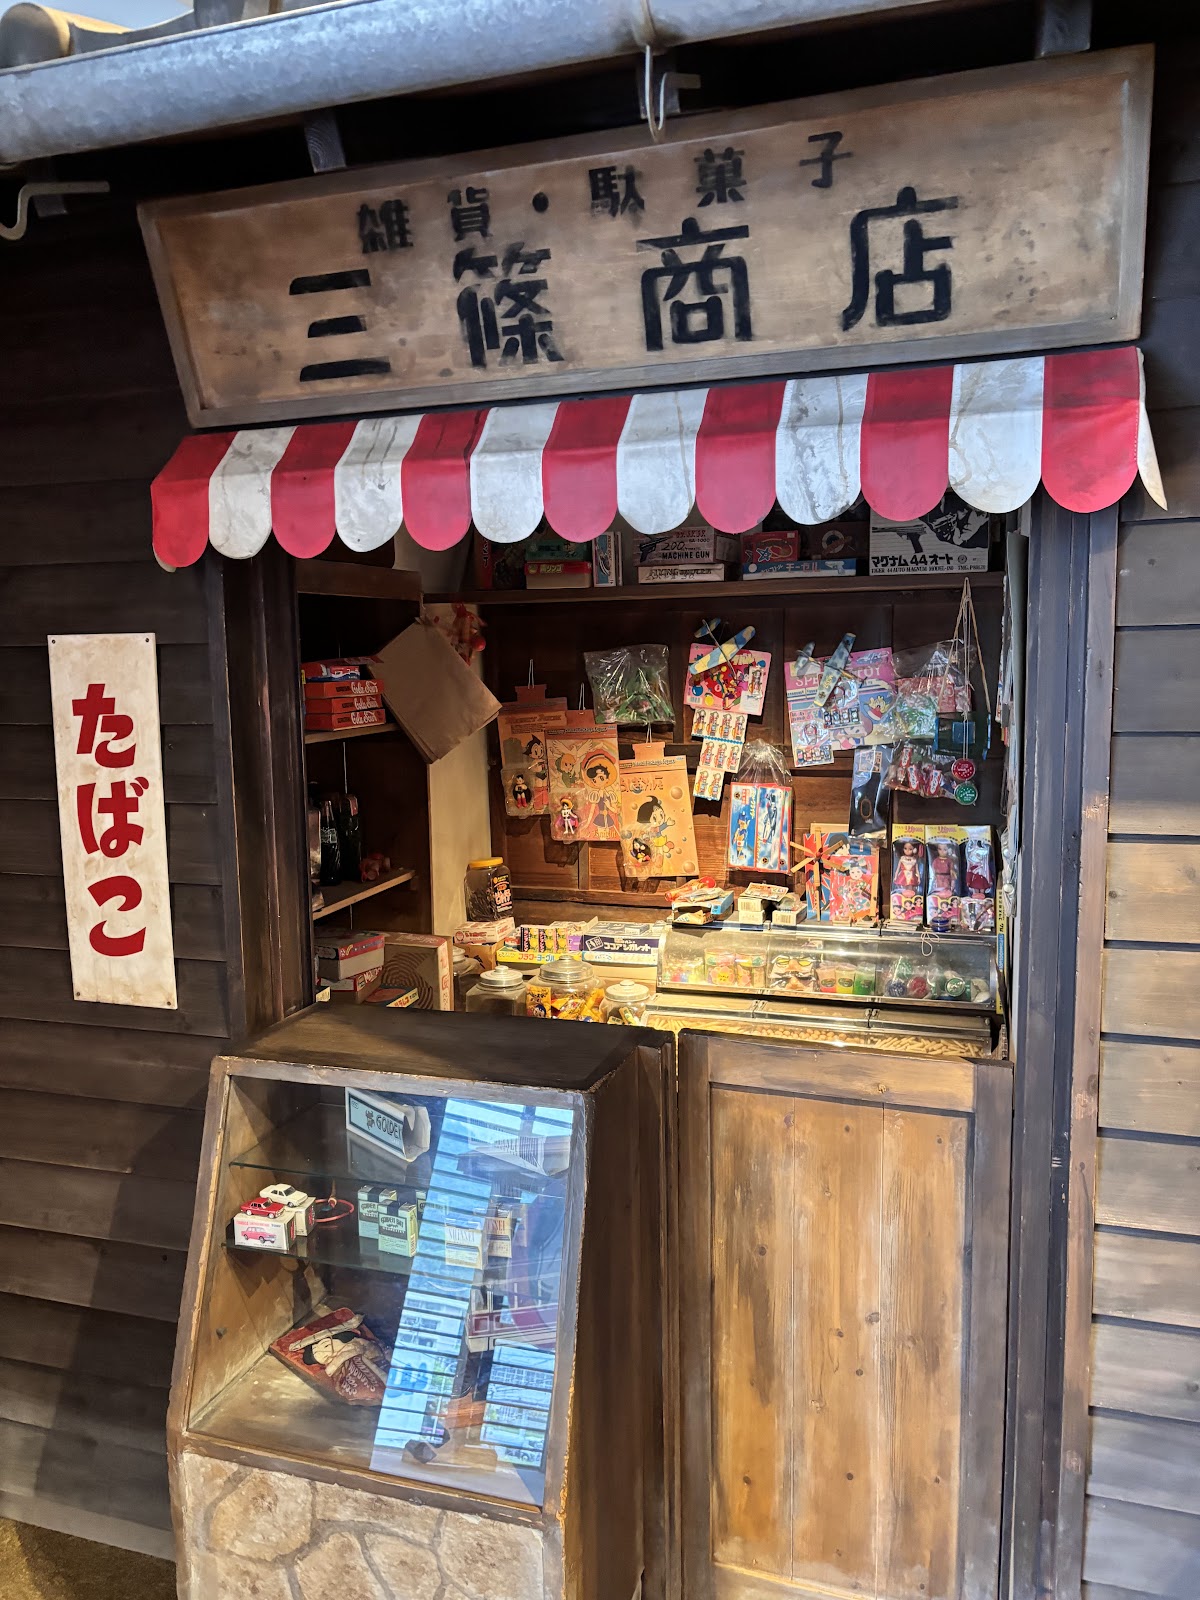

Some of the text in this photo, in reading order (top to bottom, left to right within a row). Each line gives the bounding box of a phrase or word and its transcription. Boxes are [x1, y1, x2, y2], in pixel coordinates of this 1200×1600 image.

[357, 131, 853, 254] 雑貨・駄菓子
[661, 541, 685, 551] 200
[662, 550, 710, 560] MACHINE GUN
[71, 683, 149, 957] たばこ
[603, 941, 652, 952] ココアシガレット
